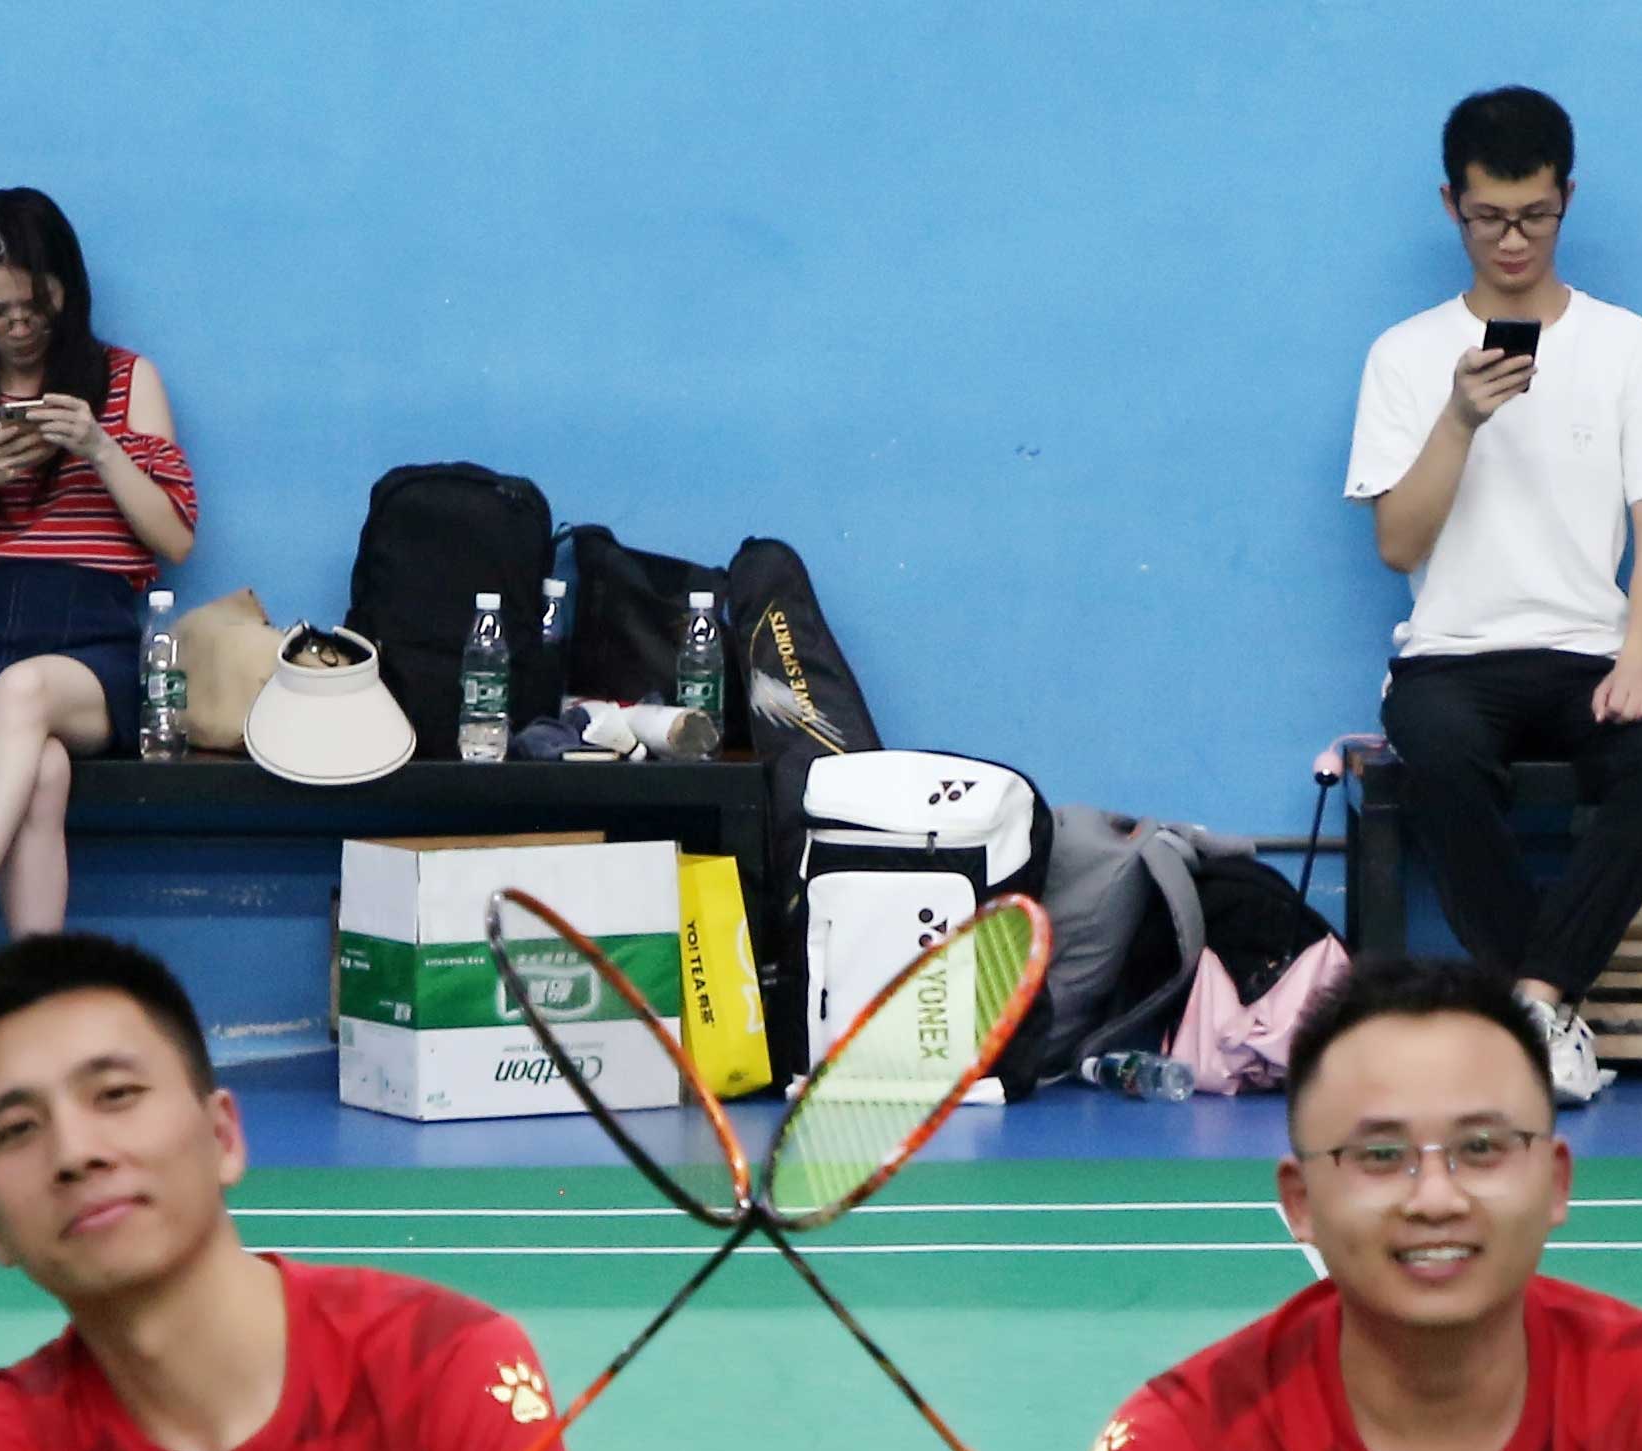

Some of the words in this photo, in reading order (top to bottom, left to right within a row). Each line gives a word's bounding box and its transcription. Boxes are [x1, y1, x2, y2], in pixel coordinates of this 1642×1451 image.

[768, 611, 803, 677] SPORTS
[690, 954, 706, 990] TEA
[918, 968, 949, 1059] YONEX
